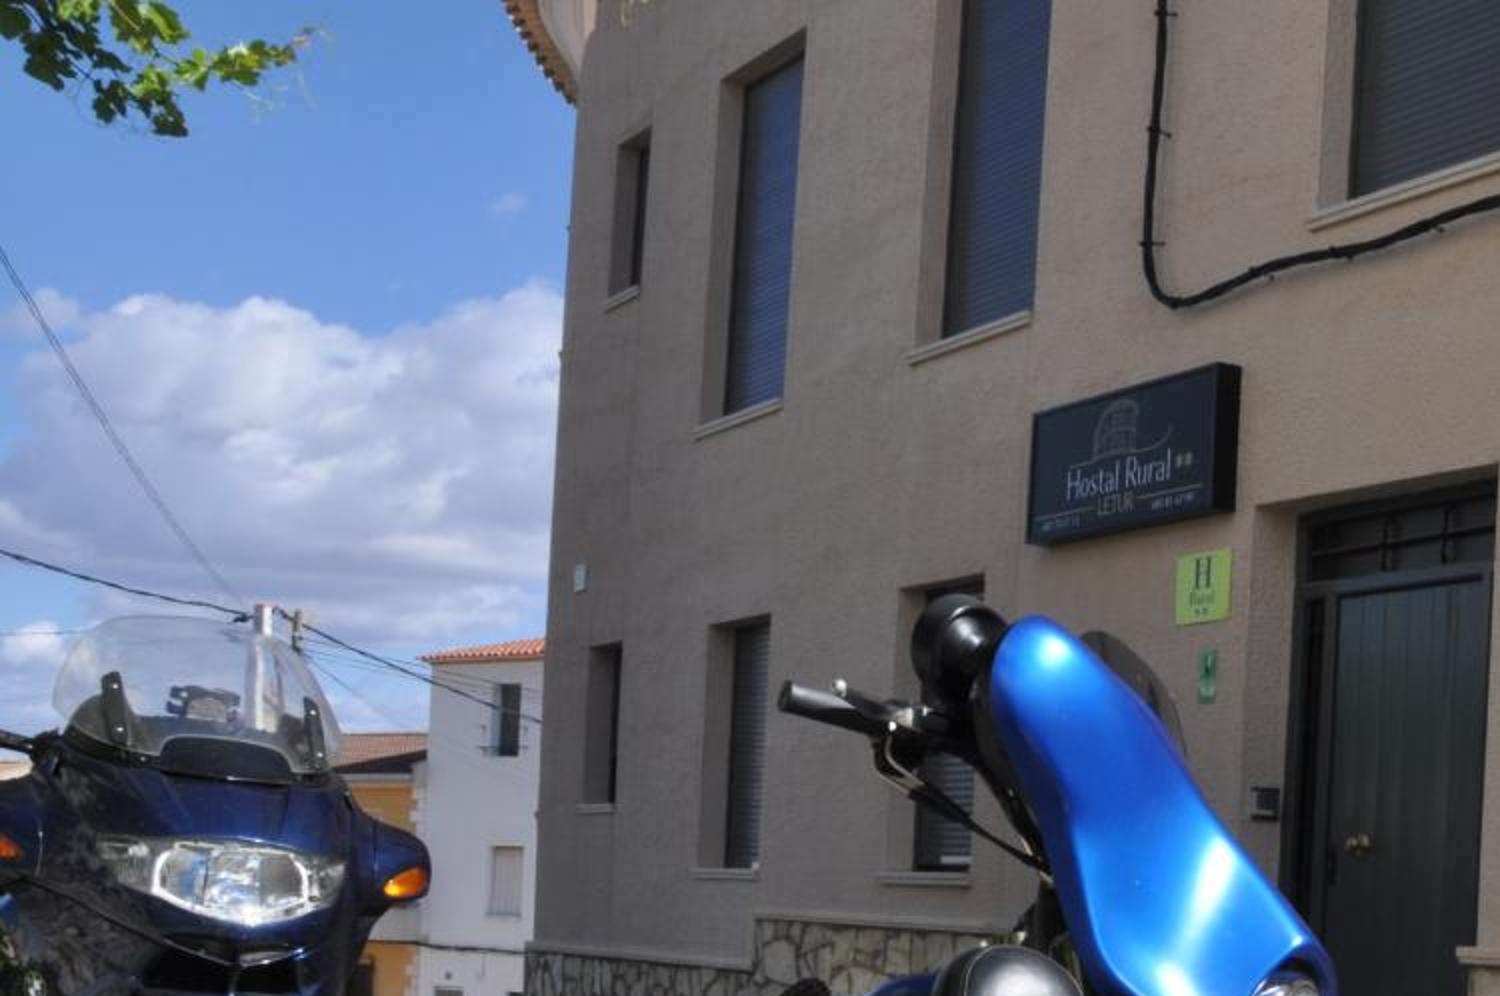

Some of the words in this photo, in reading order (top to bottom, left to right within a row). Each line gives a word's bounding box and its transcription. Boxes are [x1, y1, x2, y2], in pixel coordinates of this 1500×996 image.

[1065, 459, 1121, 501] Hostal
[1125, 447, 1172, 489] Rural
[1193, 555, 1213, 589] H
